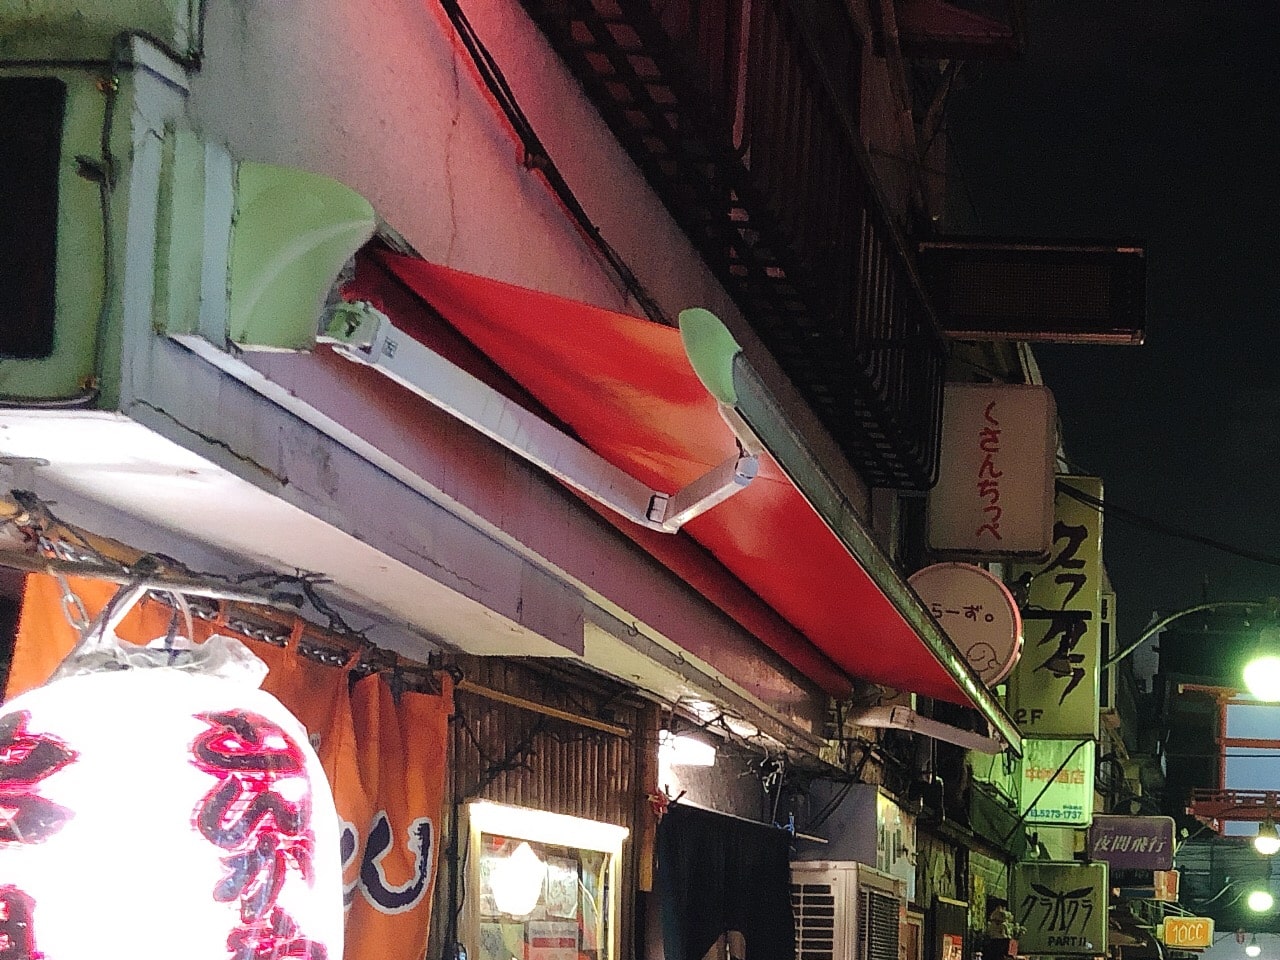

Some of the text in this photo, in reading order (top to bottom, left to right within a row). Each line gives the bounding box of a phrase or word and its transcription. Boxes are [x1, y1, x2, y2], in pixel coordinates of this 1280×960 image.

[1014, 709, 1044, 725] 2F
[1094, 835, 1167, 853] 夜間飛行
[1048, 936, 1077, 947] PART
